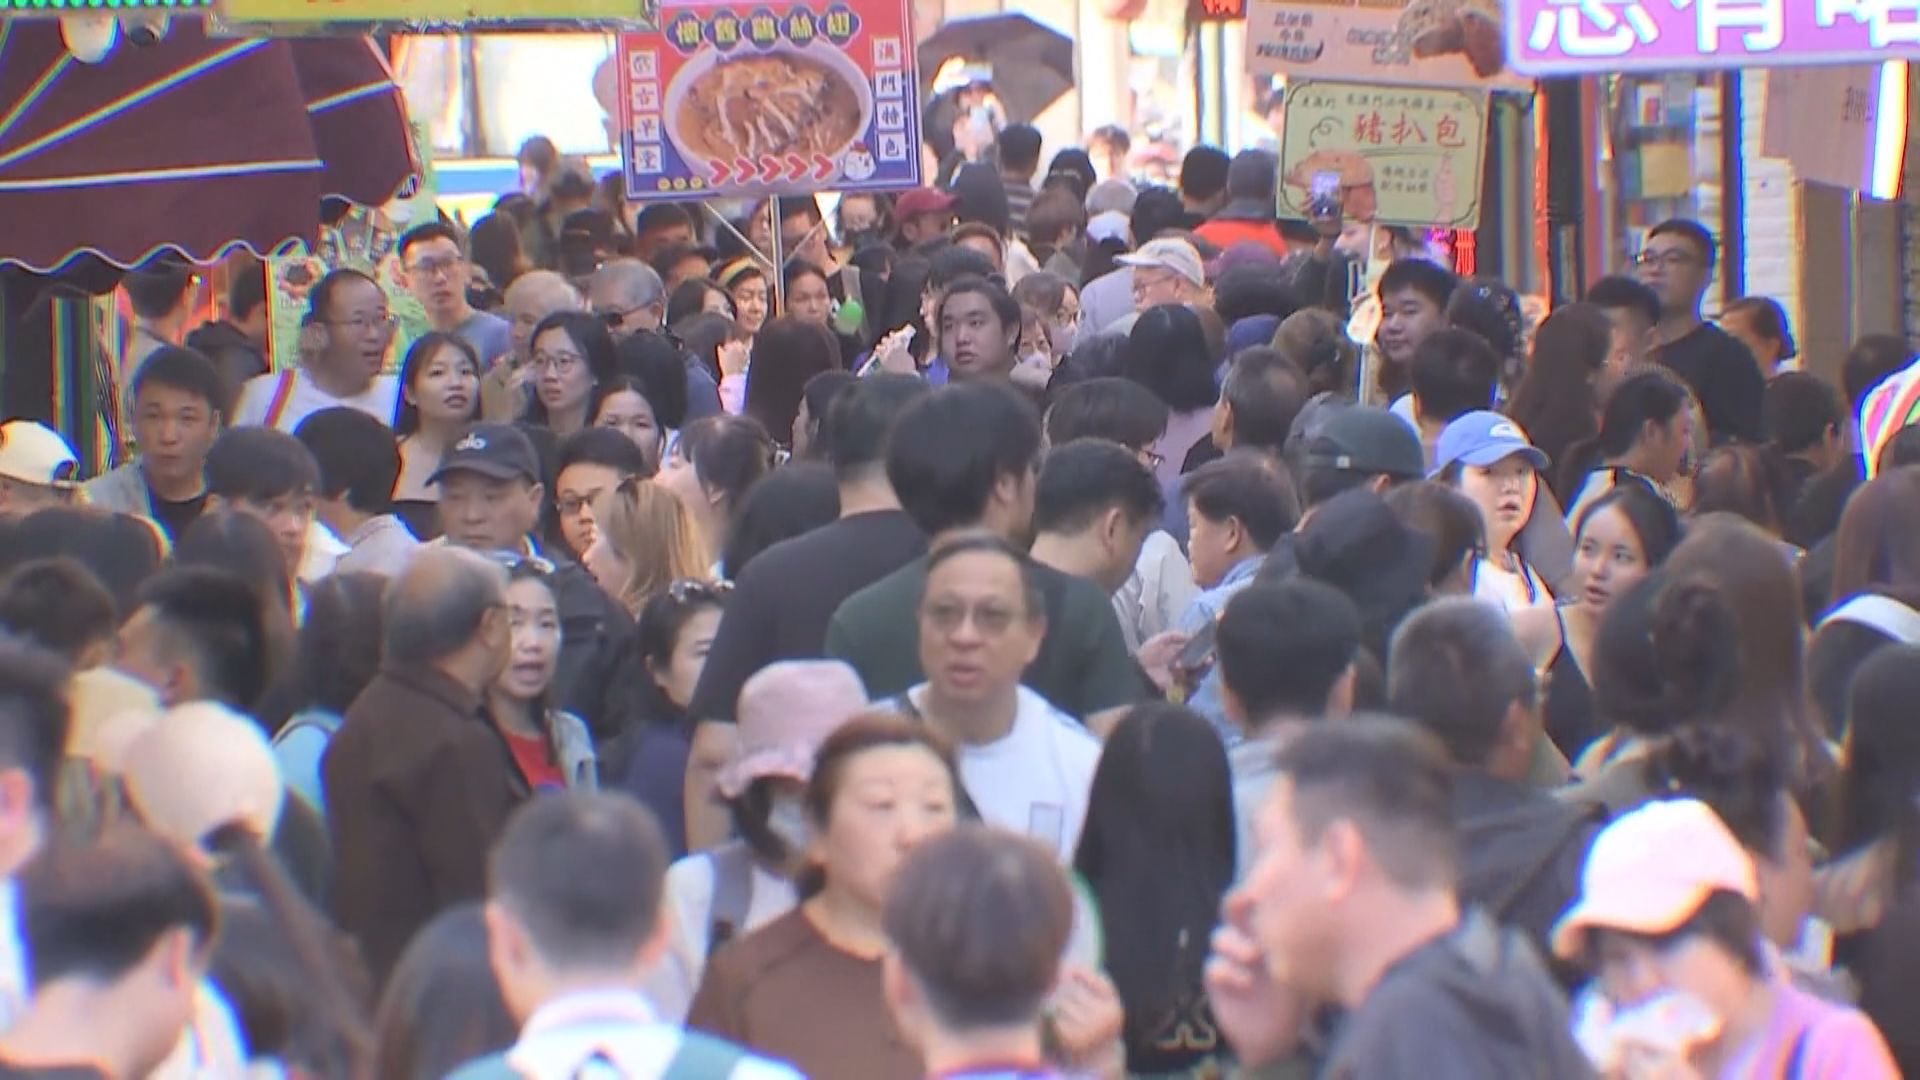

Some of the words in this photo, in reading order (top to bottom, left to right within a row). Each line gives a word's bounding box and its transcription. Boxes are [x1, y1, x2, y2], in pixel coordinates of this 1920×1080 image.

[877, 40, 901, 158] 澳門特色
[1353, 110, 1466, 147] 豬扒包
